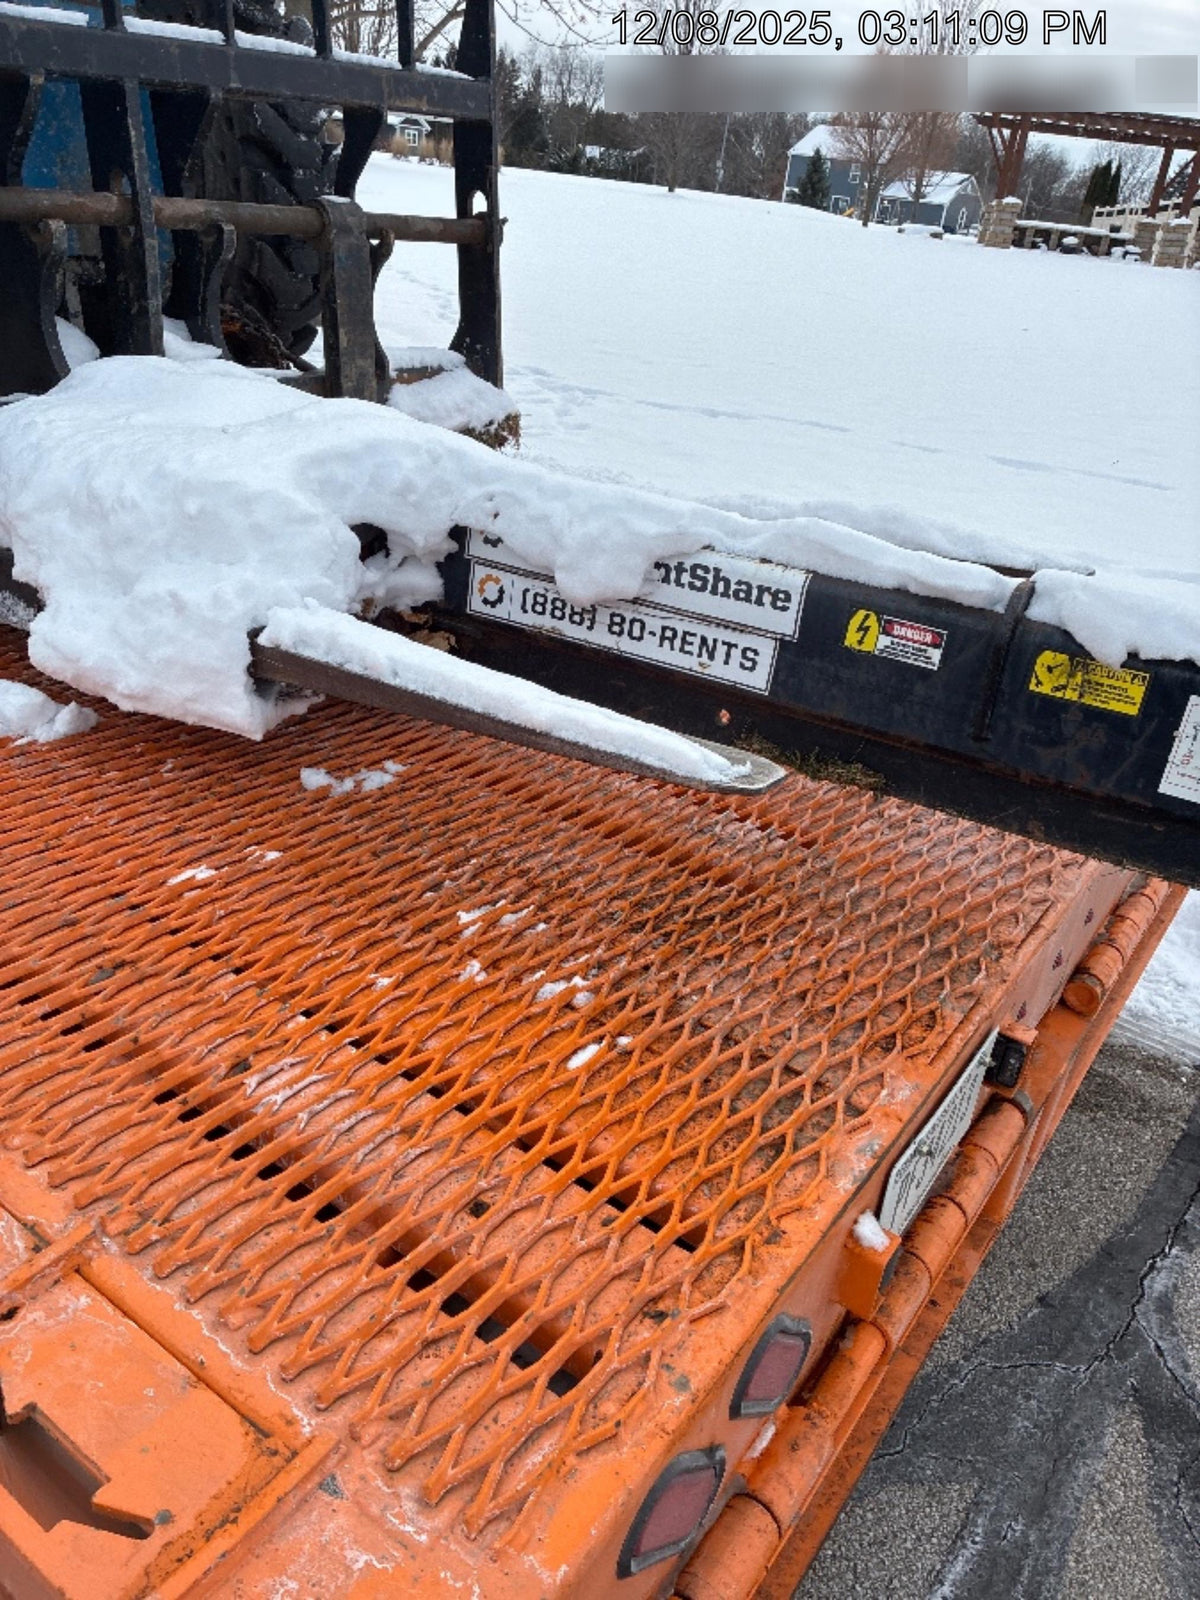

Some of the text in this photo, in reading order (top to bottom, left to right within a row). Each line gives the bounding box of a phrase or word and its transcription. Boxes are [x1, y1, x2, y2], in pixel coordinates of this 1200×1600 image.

[654, 561, 792, 612] ntShare
[607, 611, 760, 673] 80-RENTS
[893, 624, 932, 644] DANGER
